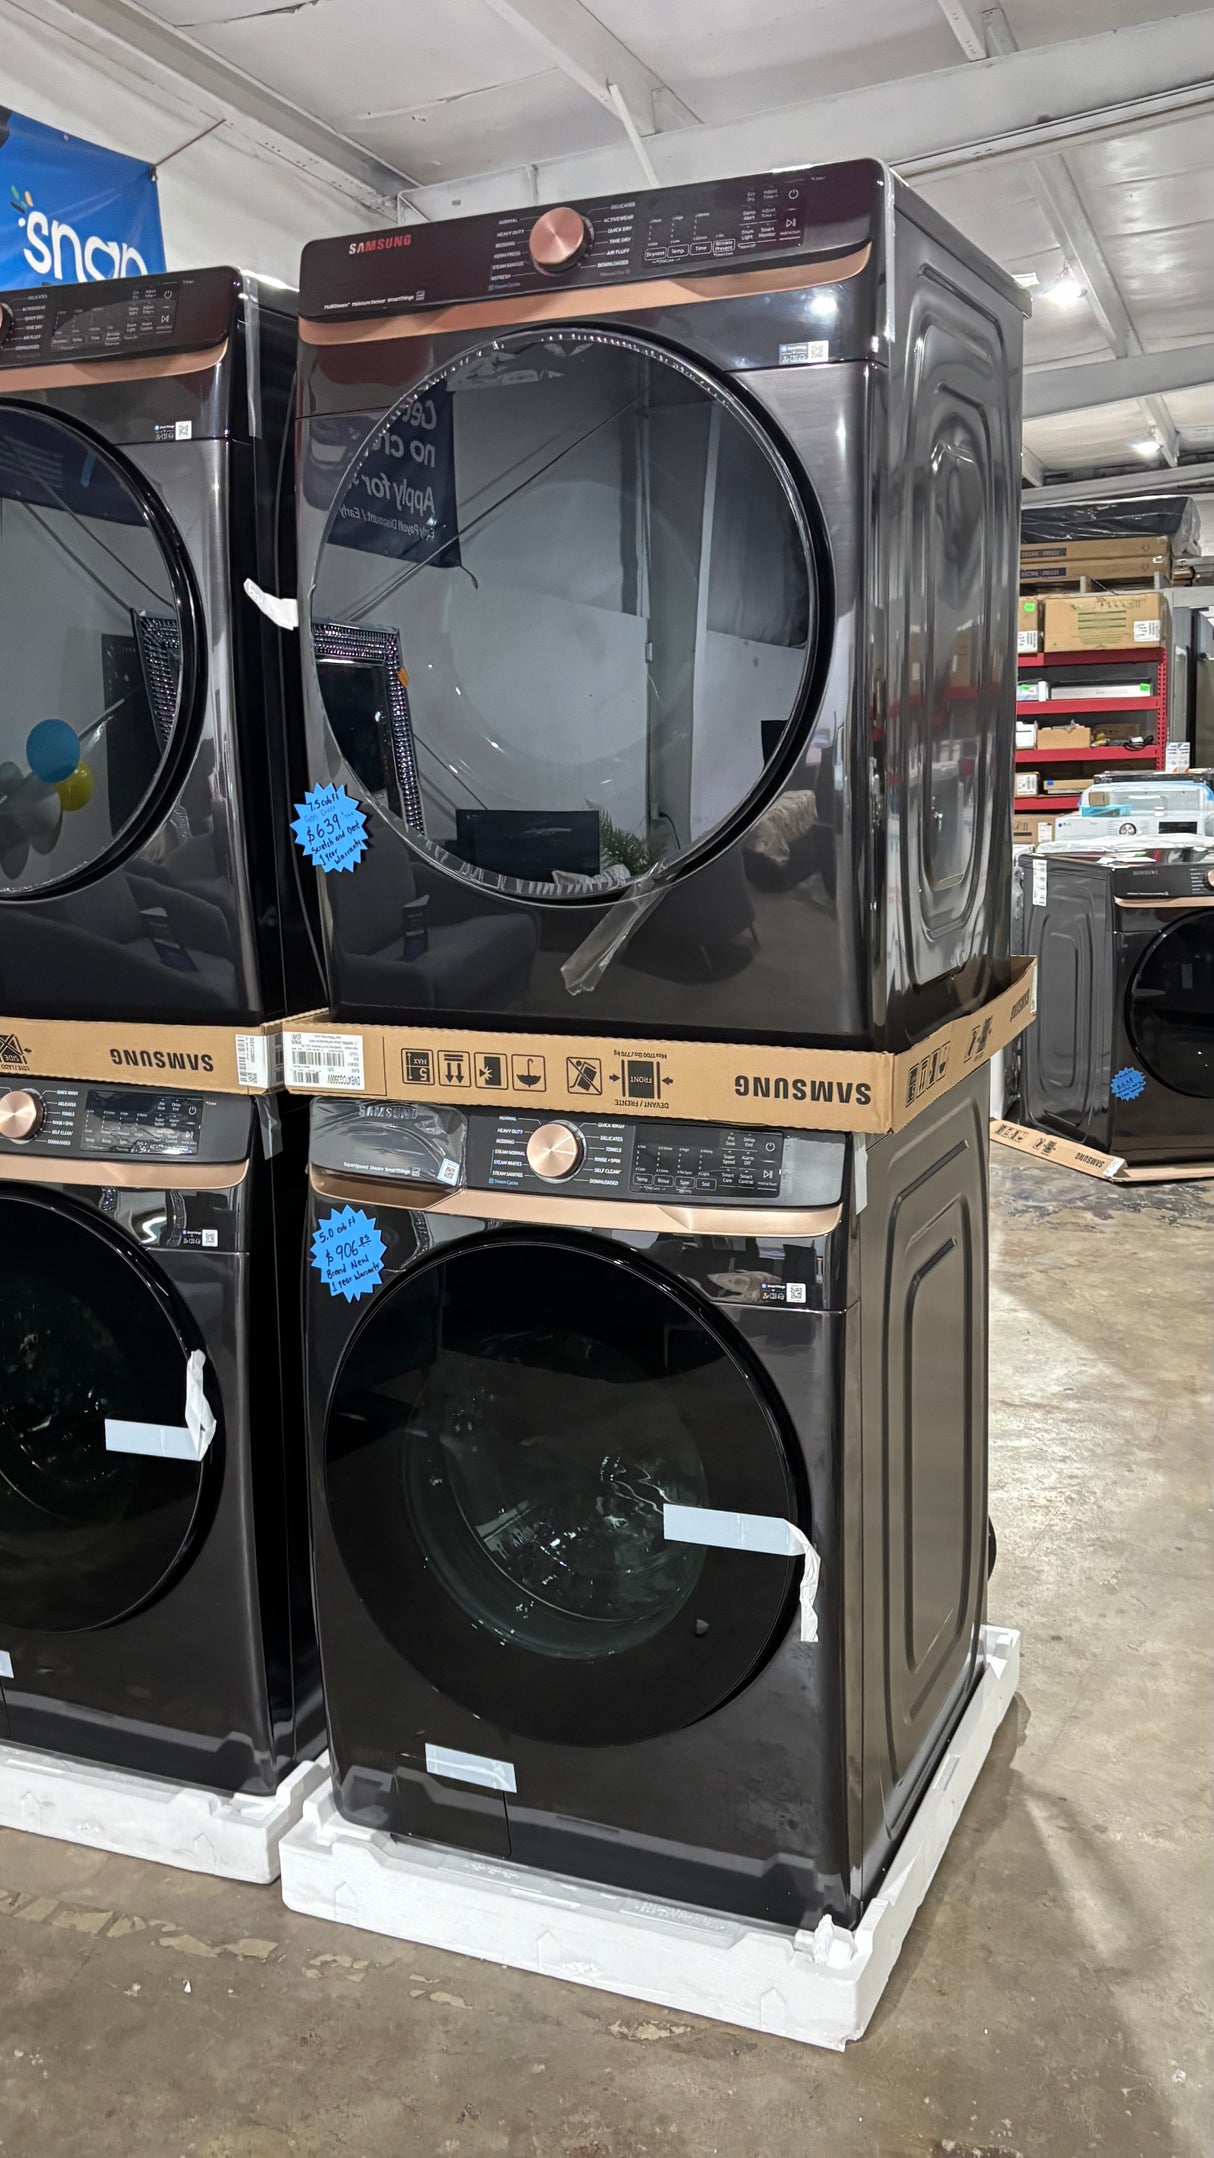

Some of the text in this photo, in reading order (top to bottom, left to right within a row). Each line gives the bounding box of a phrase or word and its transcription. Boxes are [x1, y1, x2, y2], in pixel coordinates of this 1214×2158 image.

[610, 202, 636, 210] DELICATES
[604, 214, 634, 222] ACTIVEWEAR
[348, 234, 412, 255] SAMSUNG
[308, 800, 320, 812] 7.5
[321, 795, 332, 807] cub
[311, 820, 361, 854] Scratch and Dent
[319, 848, 338, 866] 1 Year
[334, 839, 361, 865] Warranty
[110, 1047, 214, 1072] SAMSUNG
[419, 1068, 427, 1081] 5
[734, 1074, 872, 1106] SAMSUNG
[358, 1105, 418, 1120] SAMSUNG
[1074, 1152, 1105, 1168] SAMSUNG
[385, 1166, 410, 1175] SmartThings
[319, 1228, 334, 1244] 5.0
[348, 1216, 356, 1227] Ft
[326, 1254, 370, 1280] Brand New
[332, 1262, 380, 1292] 1 Year Warranty
